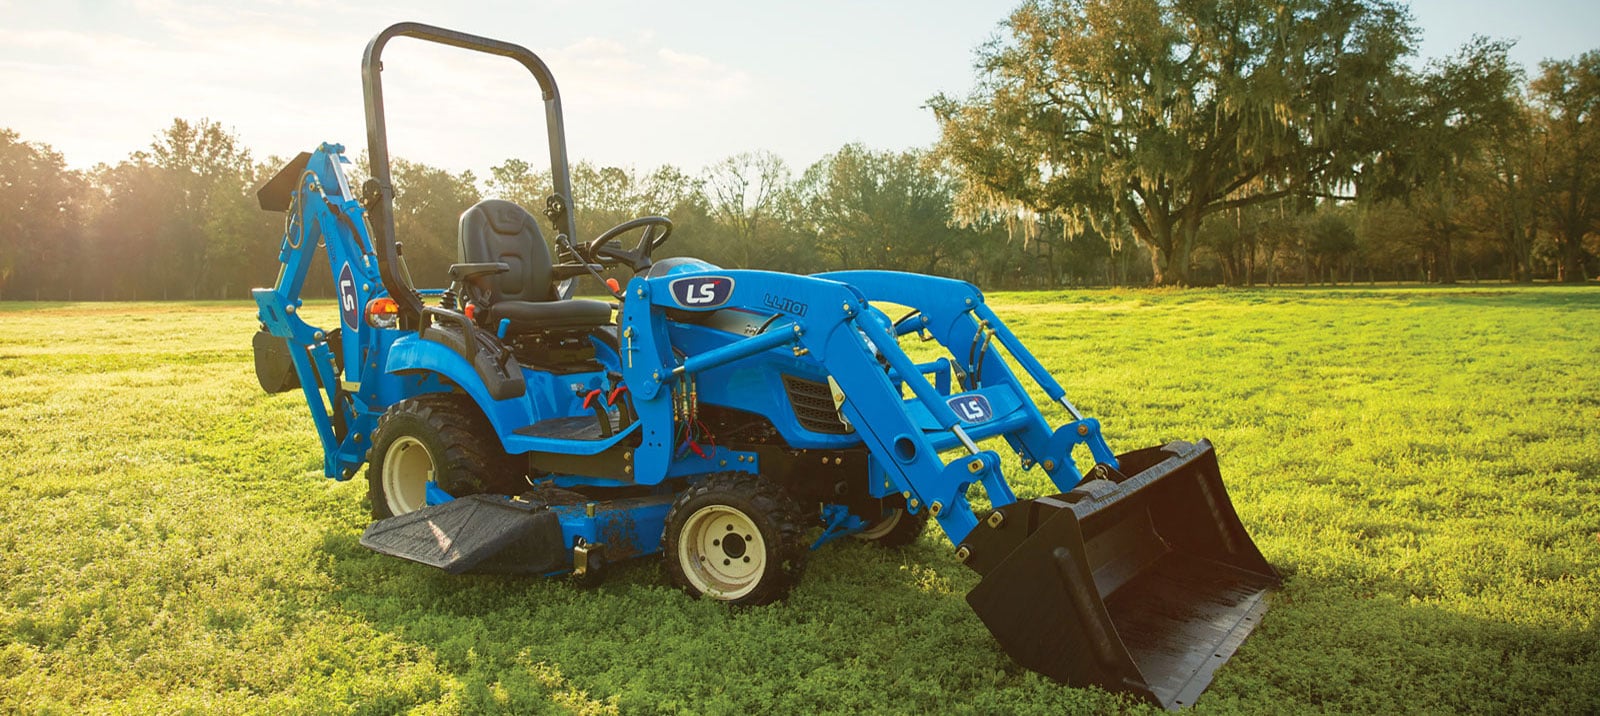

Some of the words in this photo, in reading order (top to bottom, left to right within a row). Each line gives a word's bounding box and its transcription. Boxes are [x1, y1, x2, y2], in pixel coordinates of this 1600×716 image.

[341, 280, 355, 312] LS
[686, 283, 715, 304] LS
[764, 293, 808, 316] LL1101
[960, 400, 983, 419] LS
